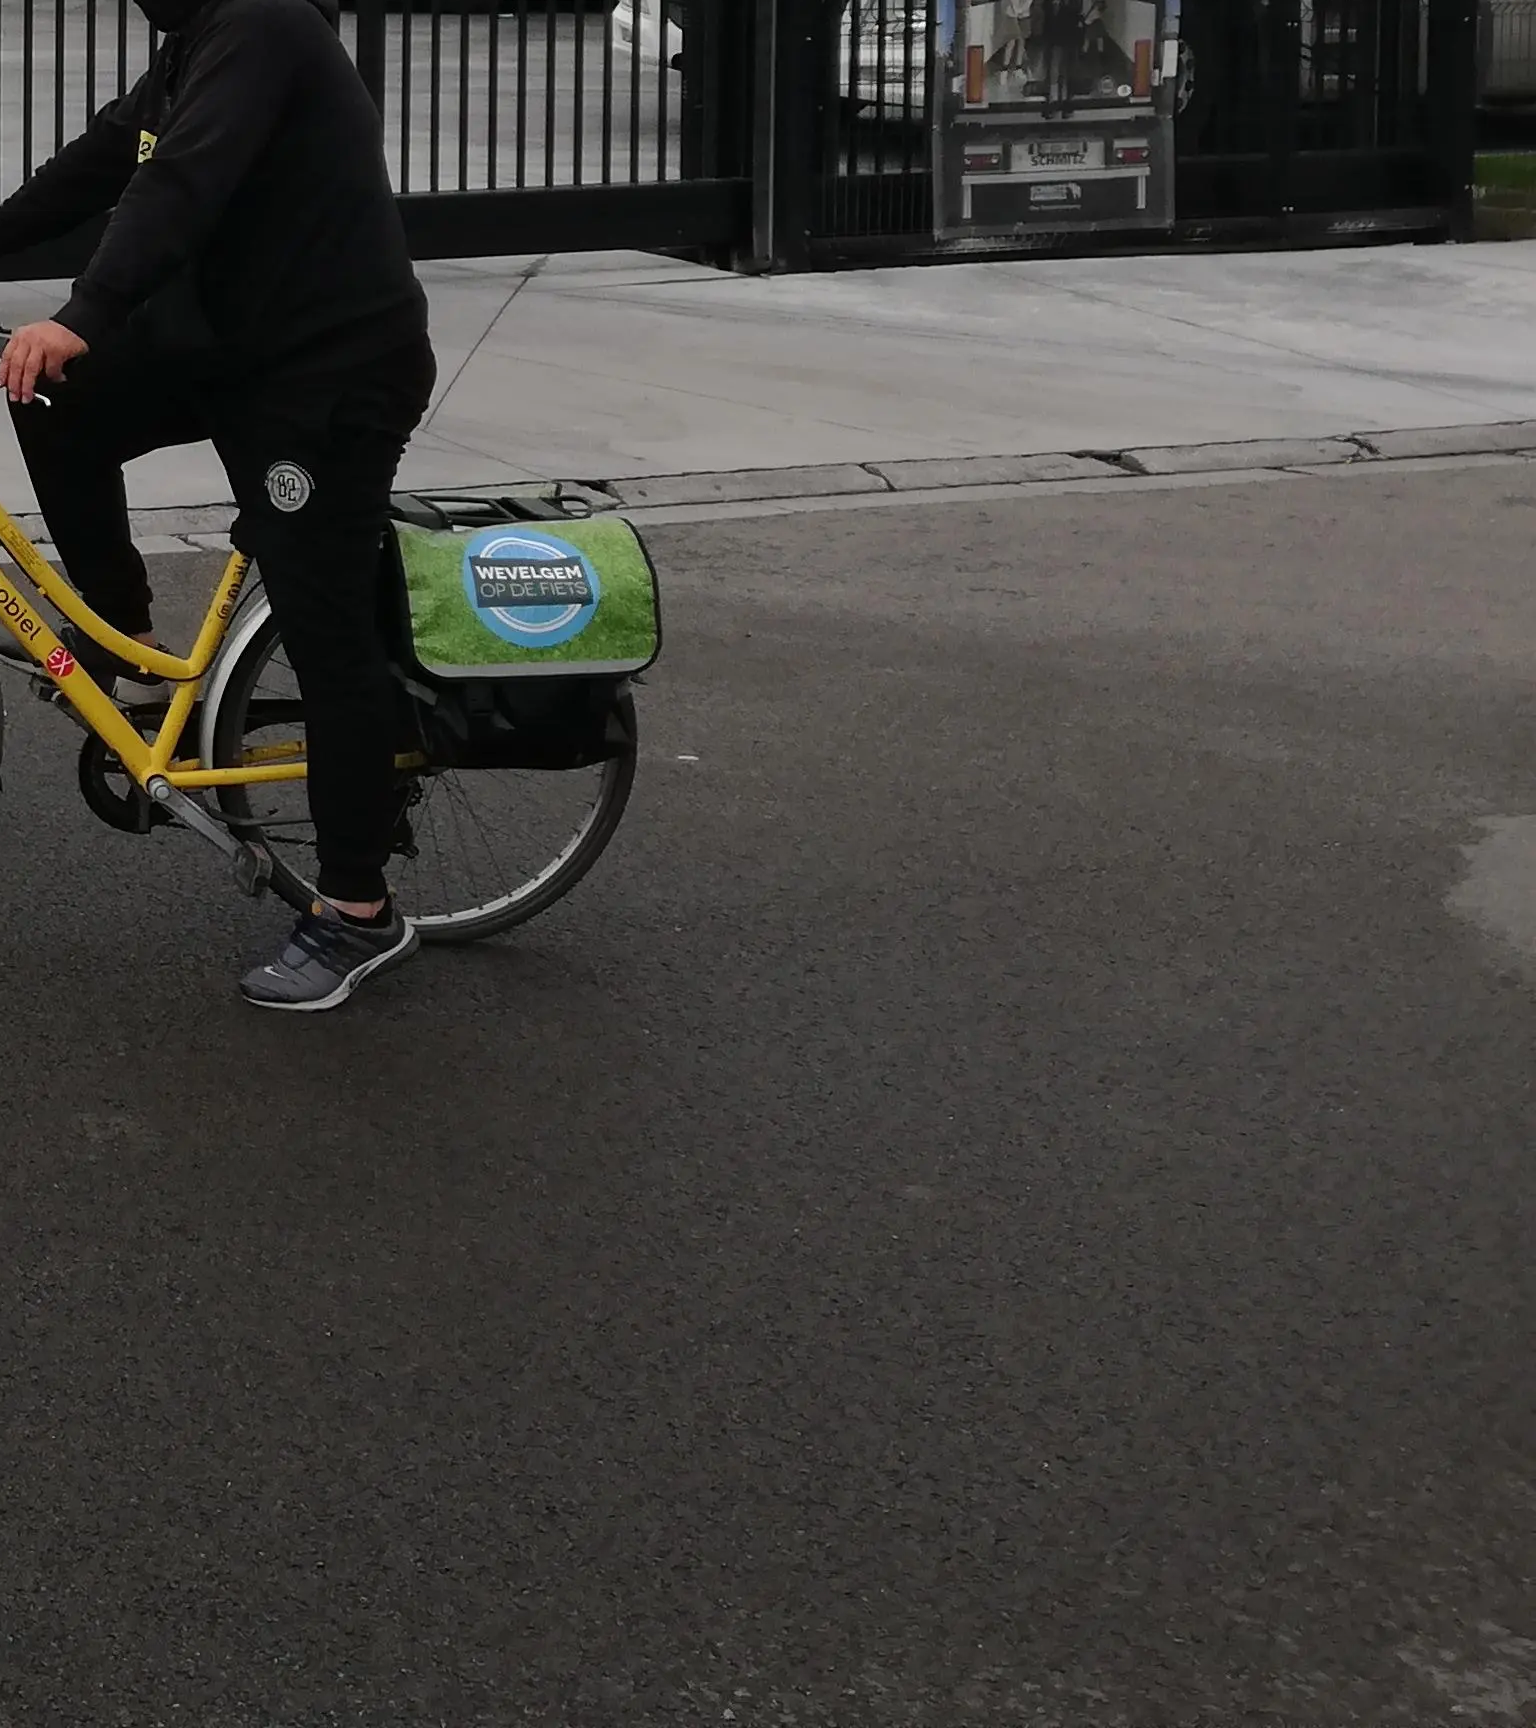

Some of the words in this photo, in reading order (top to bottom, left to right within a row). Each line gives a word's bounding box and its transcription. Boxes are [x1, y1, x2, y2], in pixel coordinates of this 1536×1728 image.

[475, 565, 583, 580] WEVELGEM
[480, 584, 506, 597] OP
[510, 583, 537, 596] DE
[540, 581, 588, 596] FIETS
